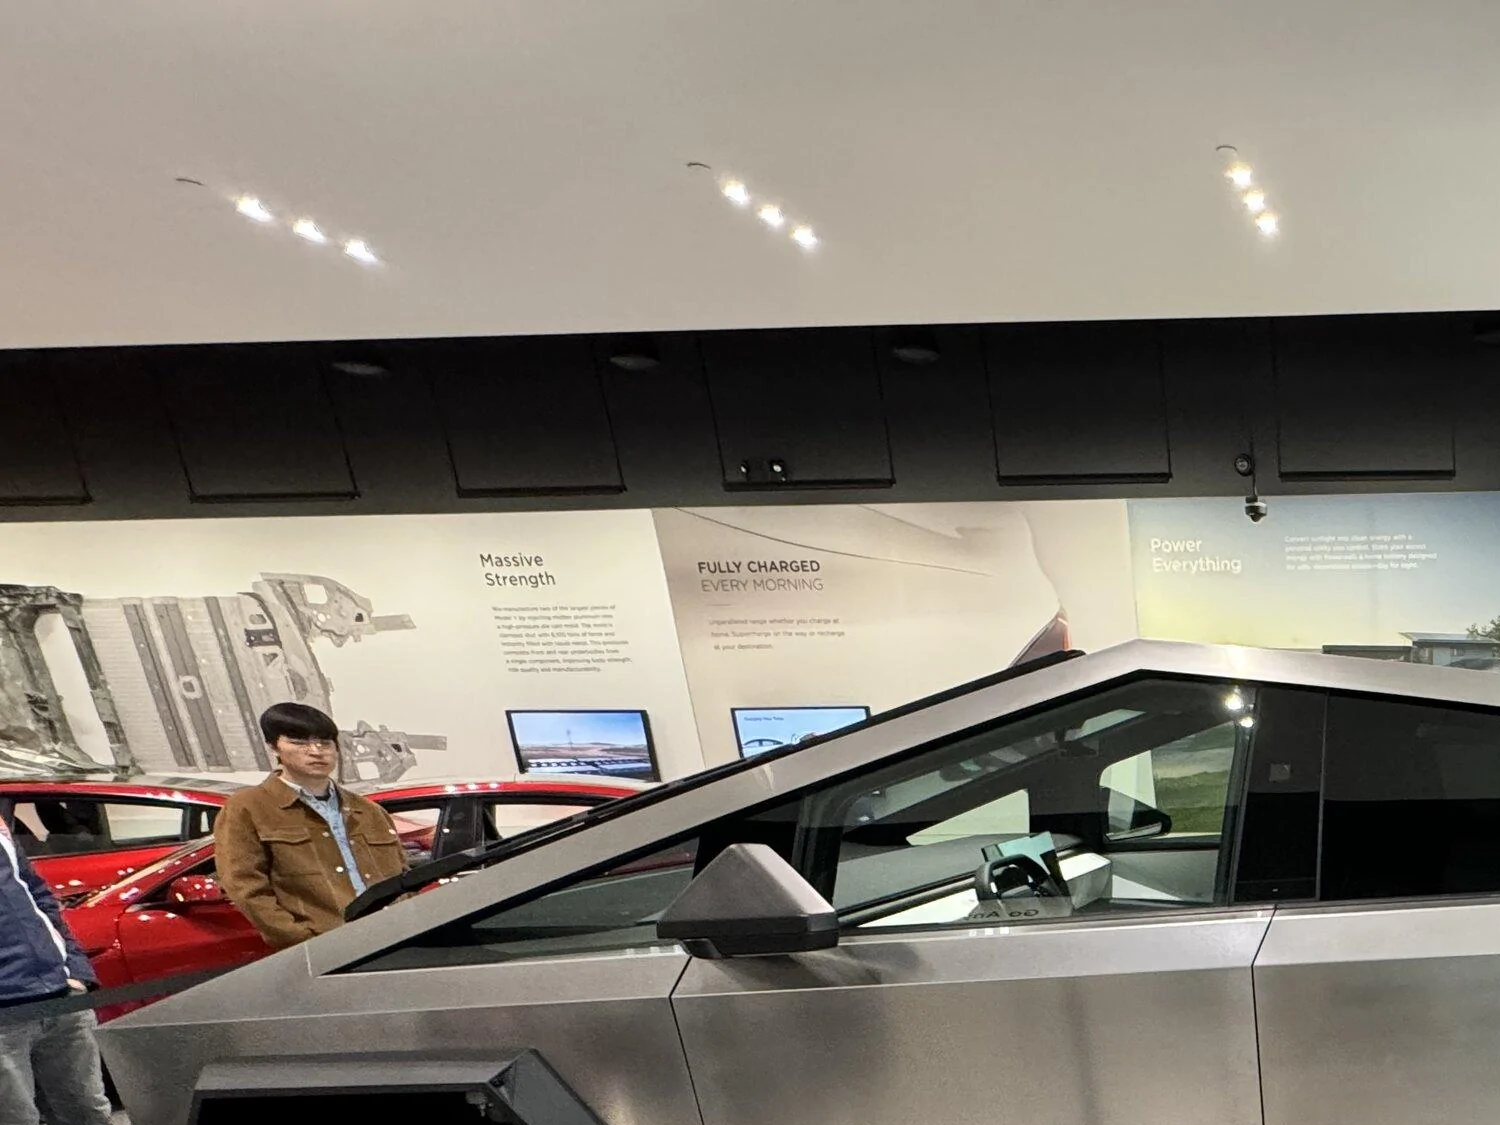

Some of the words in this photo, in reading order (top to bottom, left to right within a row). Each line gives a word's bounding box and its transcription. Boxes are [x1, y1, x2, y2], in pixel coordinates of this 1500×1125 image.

[1150, 538, 1202, 552] Power
[480, 552, 544, 568] Massive
[698, 561, 742, 574] FULLY
[748, 560, 820, 573] CHARGED
[1152, 557, 1242, 574] Everything
[484, 571, 556, 588] Strength
[701, 579, 748, 592] EVERY
[753, 578, 824, 592] MORNING
